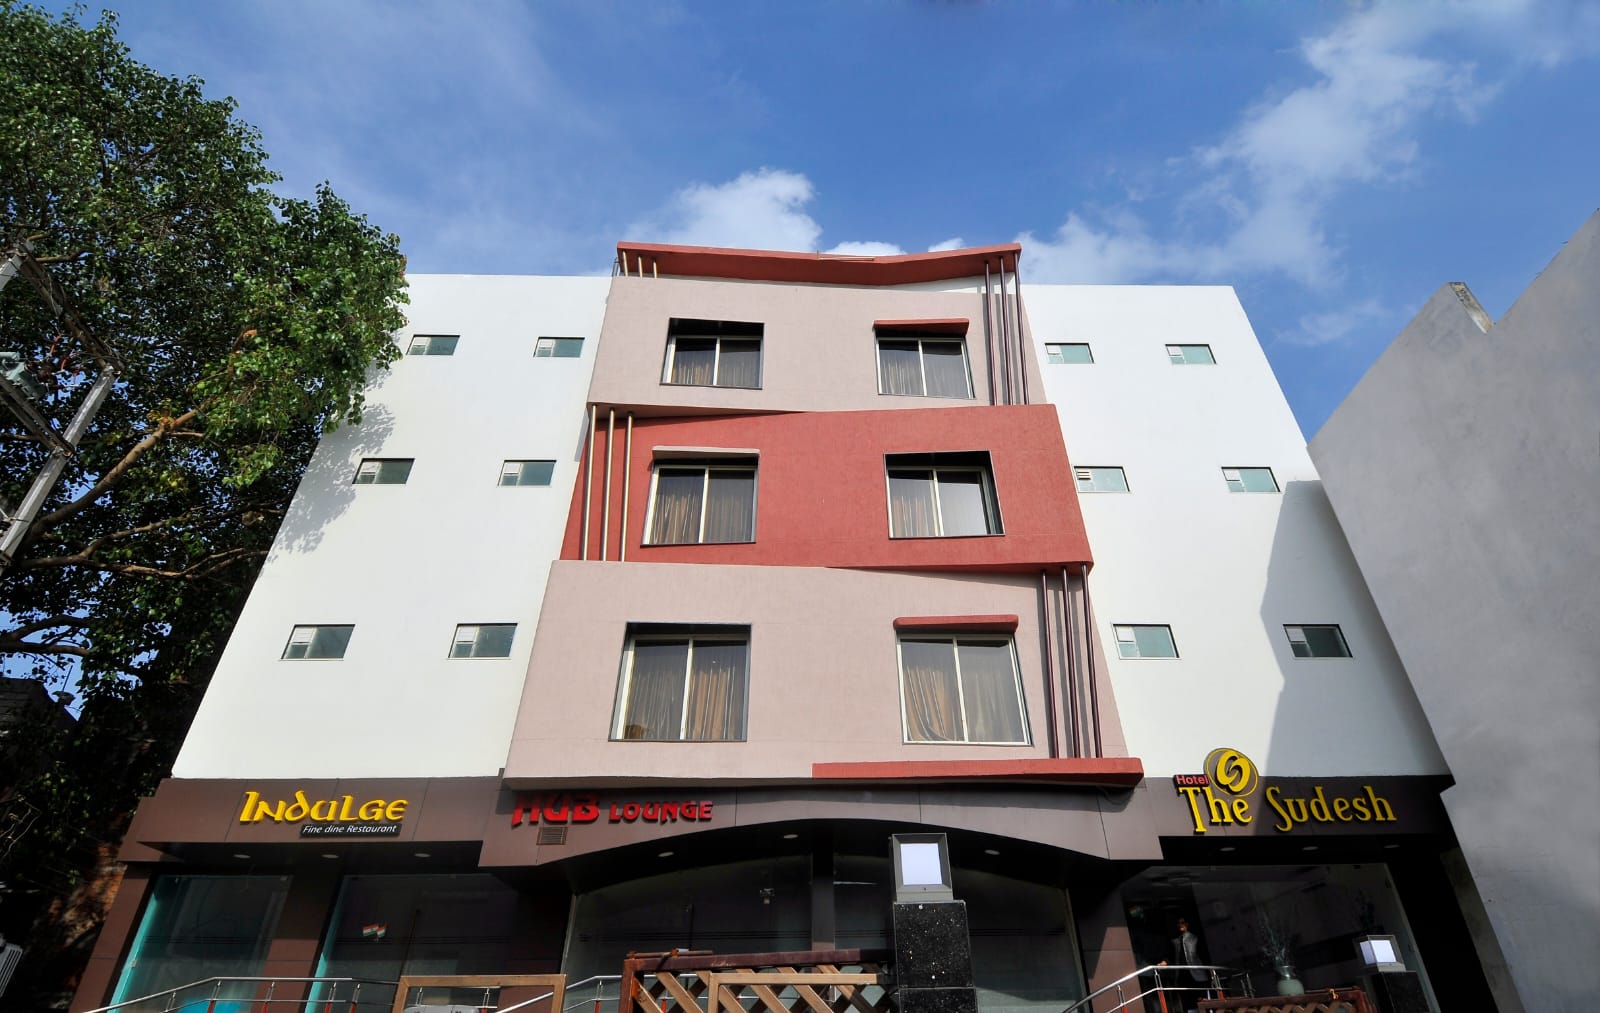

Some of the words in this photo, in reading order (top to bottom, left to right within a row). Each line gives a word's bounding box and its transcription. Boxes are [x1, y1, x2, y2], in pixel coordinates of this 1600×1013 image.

[1175, 774, 1210, 785] Hotel
[511, 792, 600, 826] HUB
[609, 801, 713, 823] LOUNGE
[1179, 786, 1253, 833] The
[1266, 785, 1397, 832] Sudesh
[302, 825, 322, 834] Fine
[324, 825, 344, 833] dine
[347, 825, 397, 834] Restaurant
